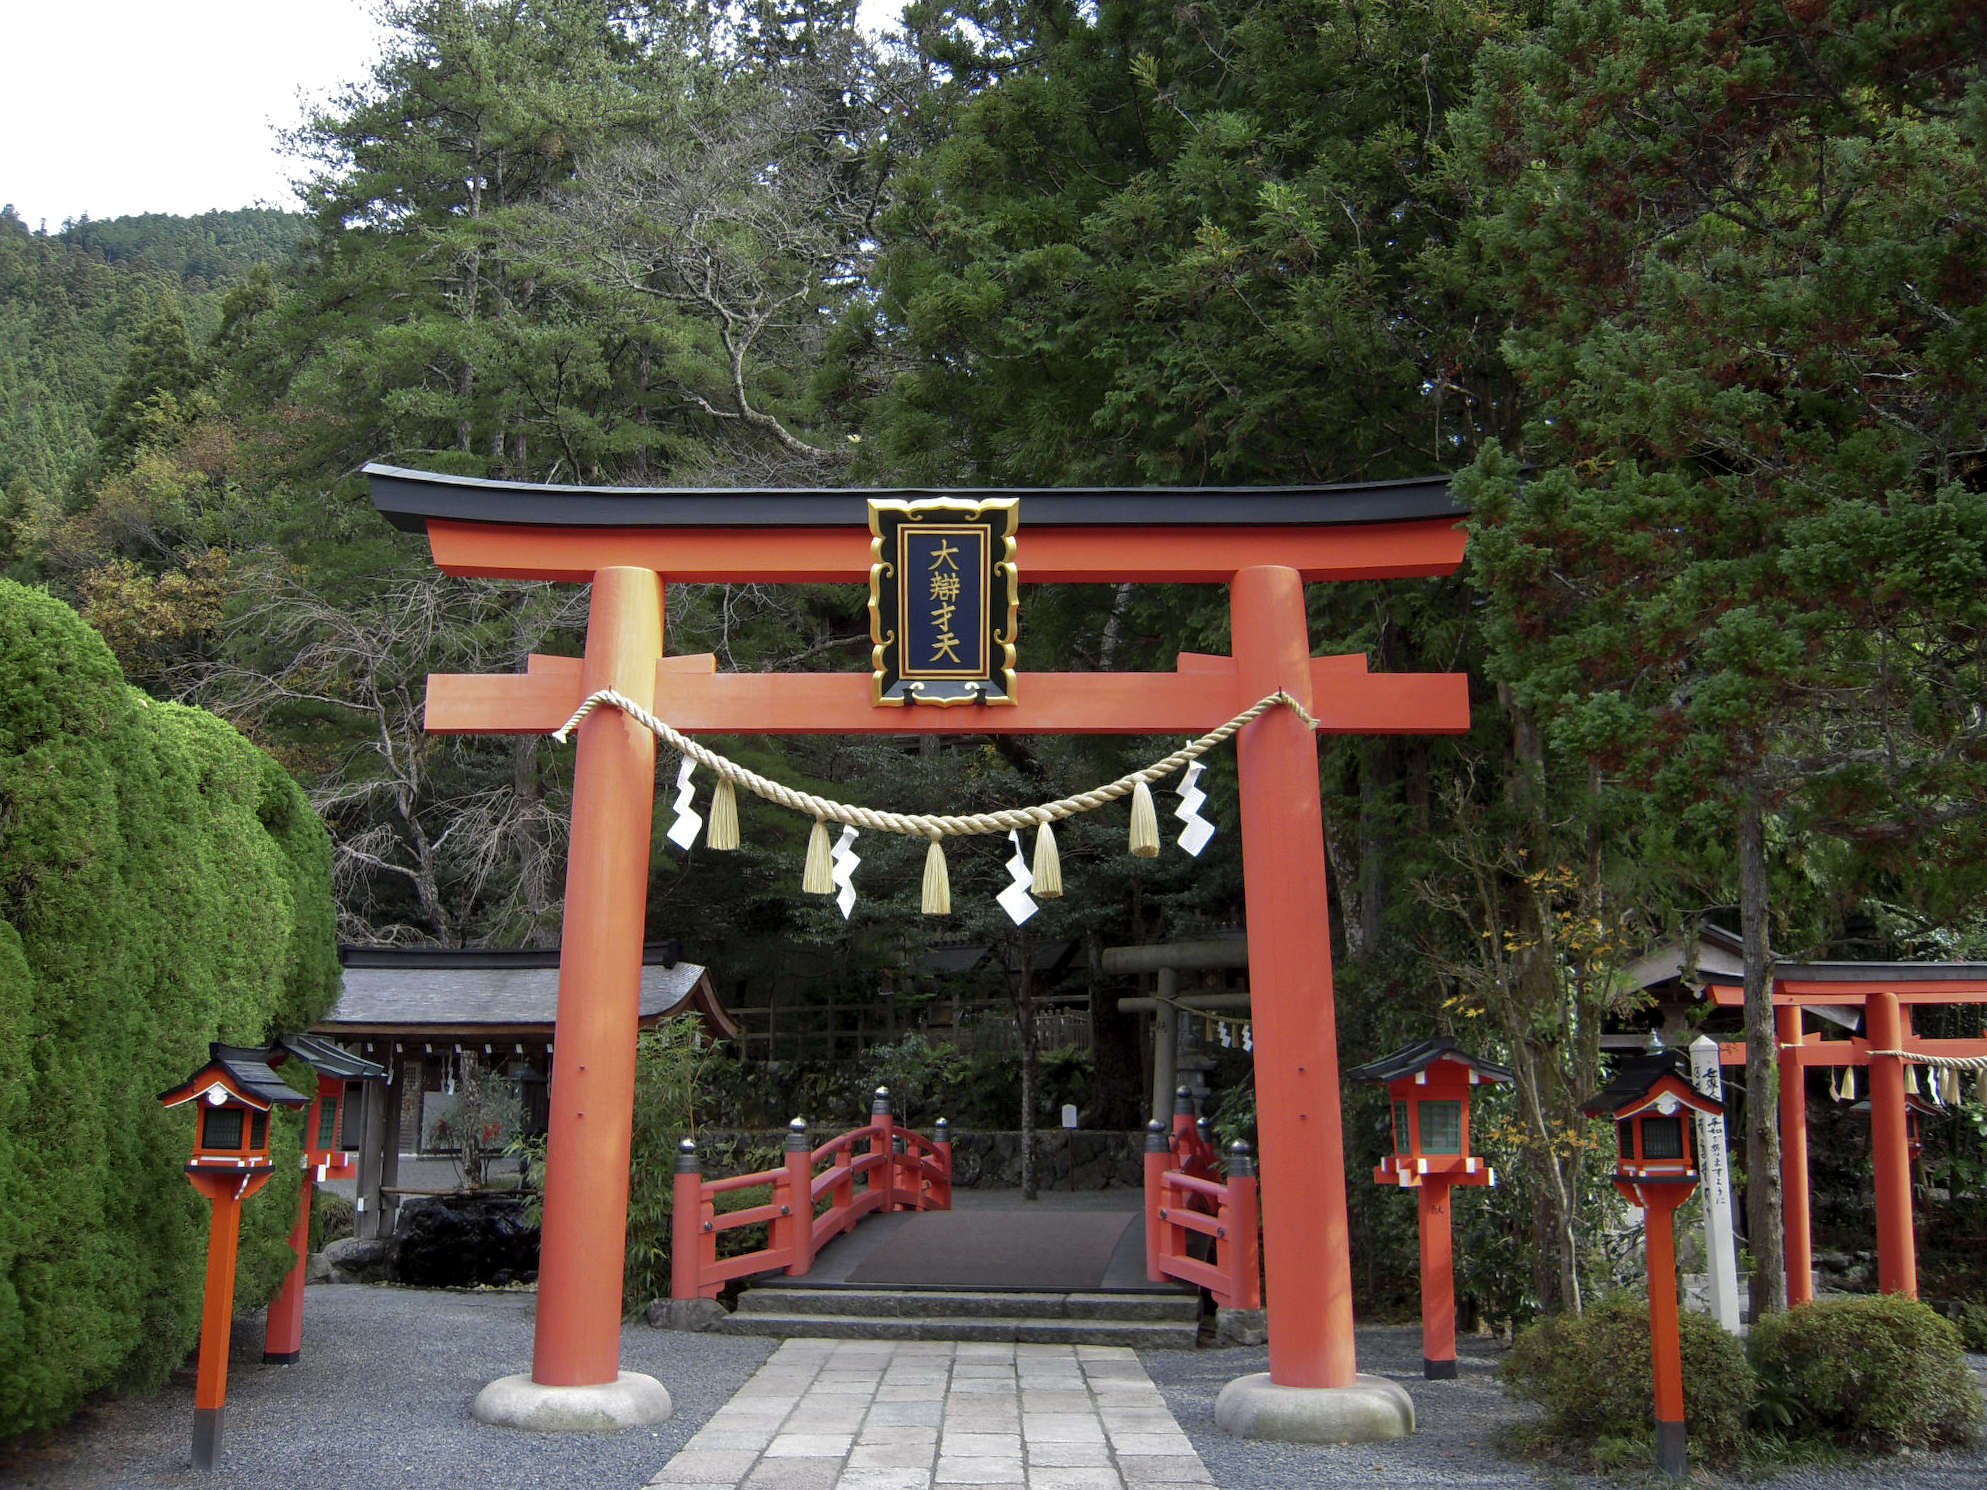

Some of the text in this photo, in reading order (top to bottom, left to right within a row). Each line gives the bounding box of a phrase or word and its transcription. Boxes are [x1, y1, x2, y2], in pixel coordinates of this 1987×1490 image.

[1702, 1067, 1727, 1205] 世界人平和でありますように
